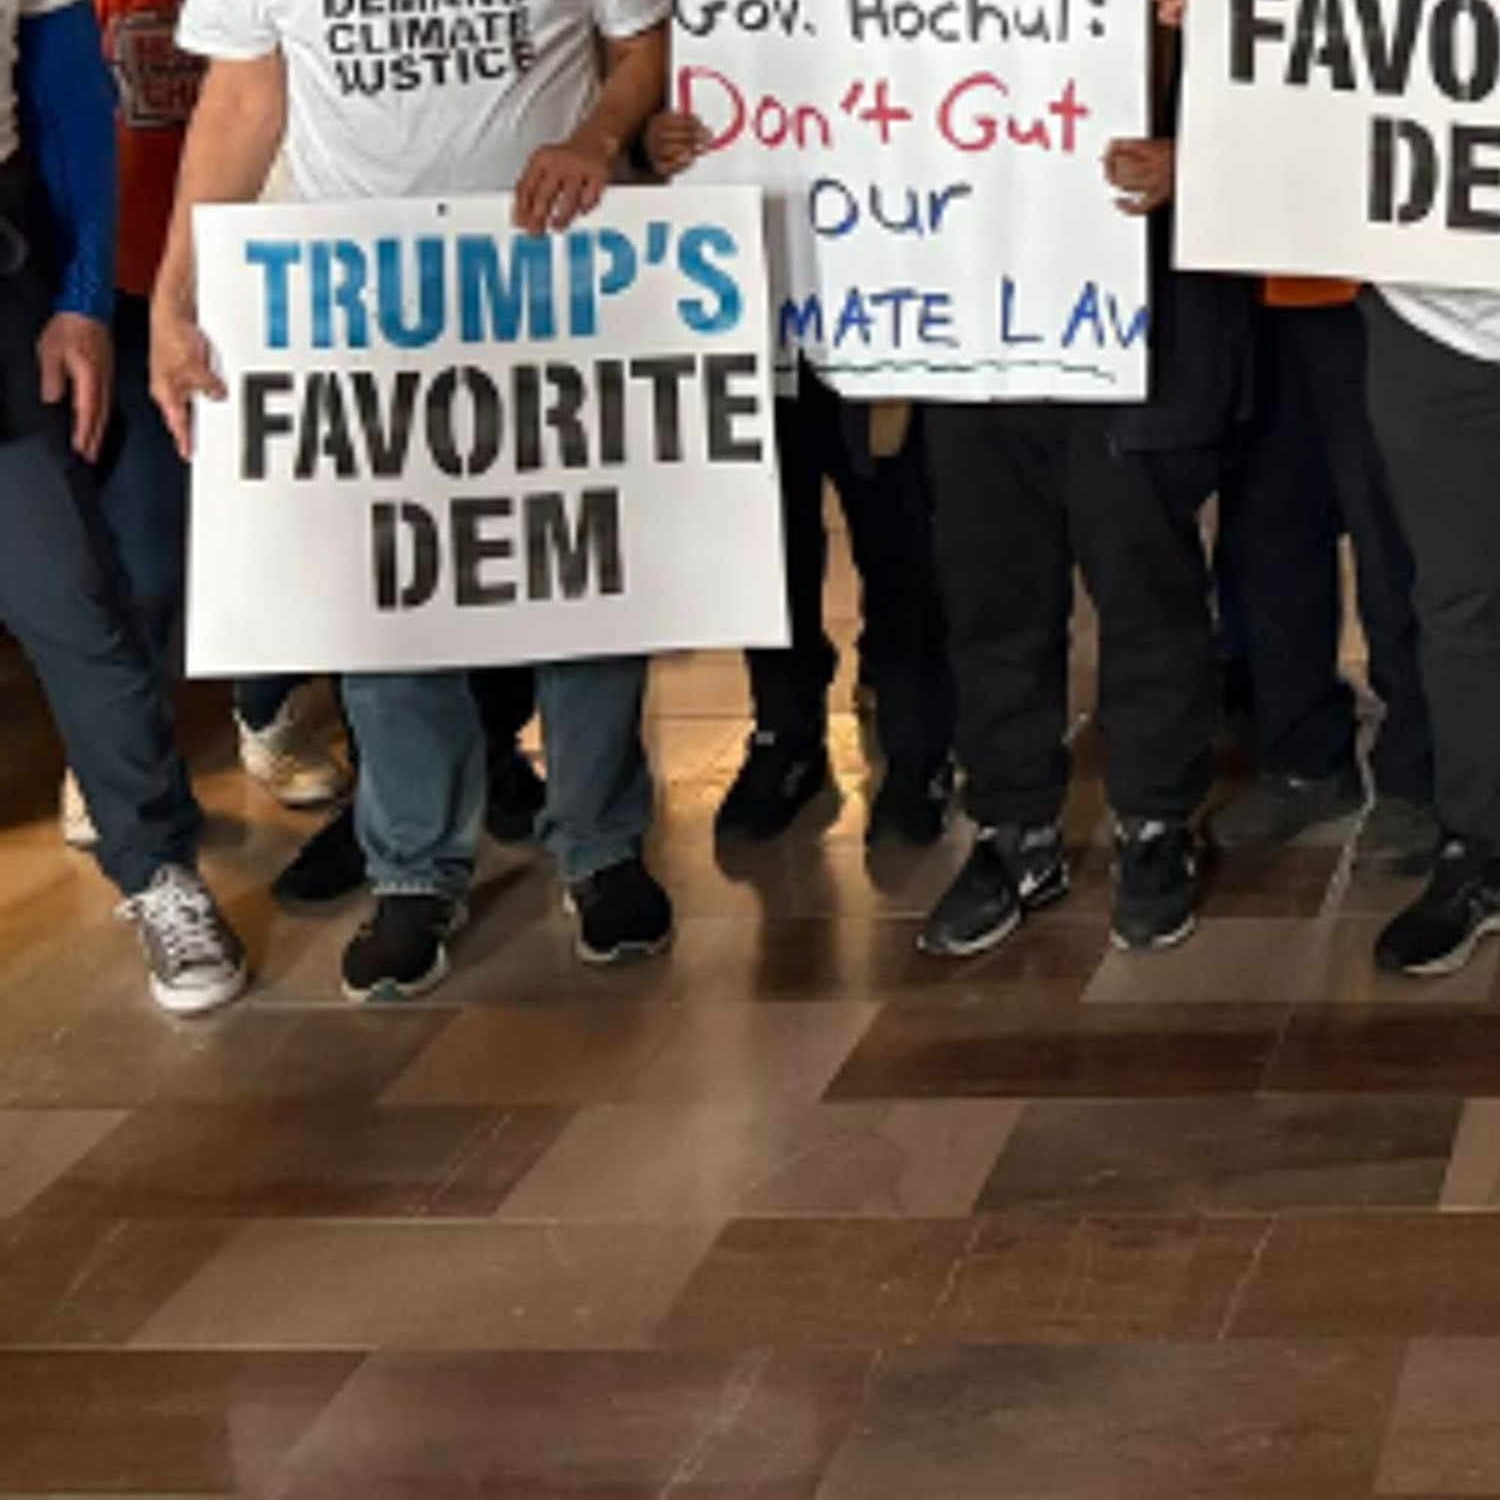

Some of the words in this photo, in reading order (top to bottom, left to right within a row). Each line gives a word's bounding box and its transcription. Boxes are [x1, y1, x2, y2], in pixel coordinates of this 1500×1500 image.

[325, 5, 533, 57] CLIMATE
[677, 65, 912, 152] Don't
[937, 72, 1091, 153] Gut
[245, 221, 743, 351] TRUMP'S
[778, 286, 962, 349] MATE
[240, 353, 763, 481] FAVORITE
[372, 487, 625, 611] DEM
